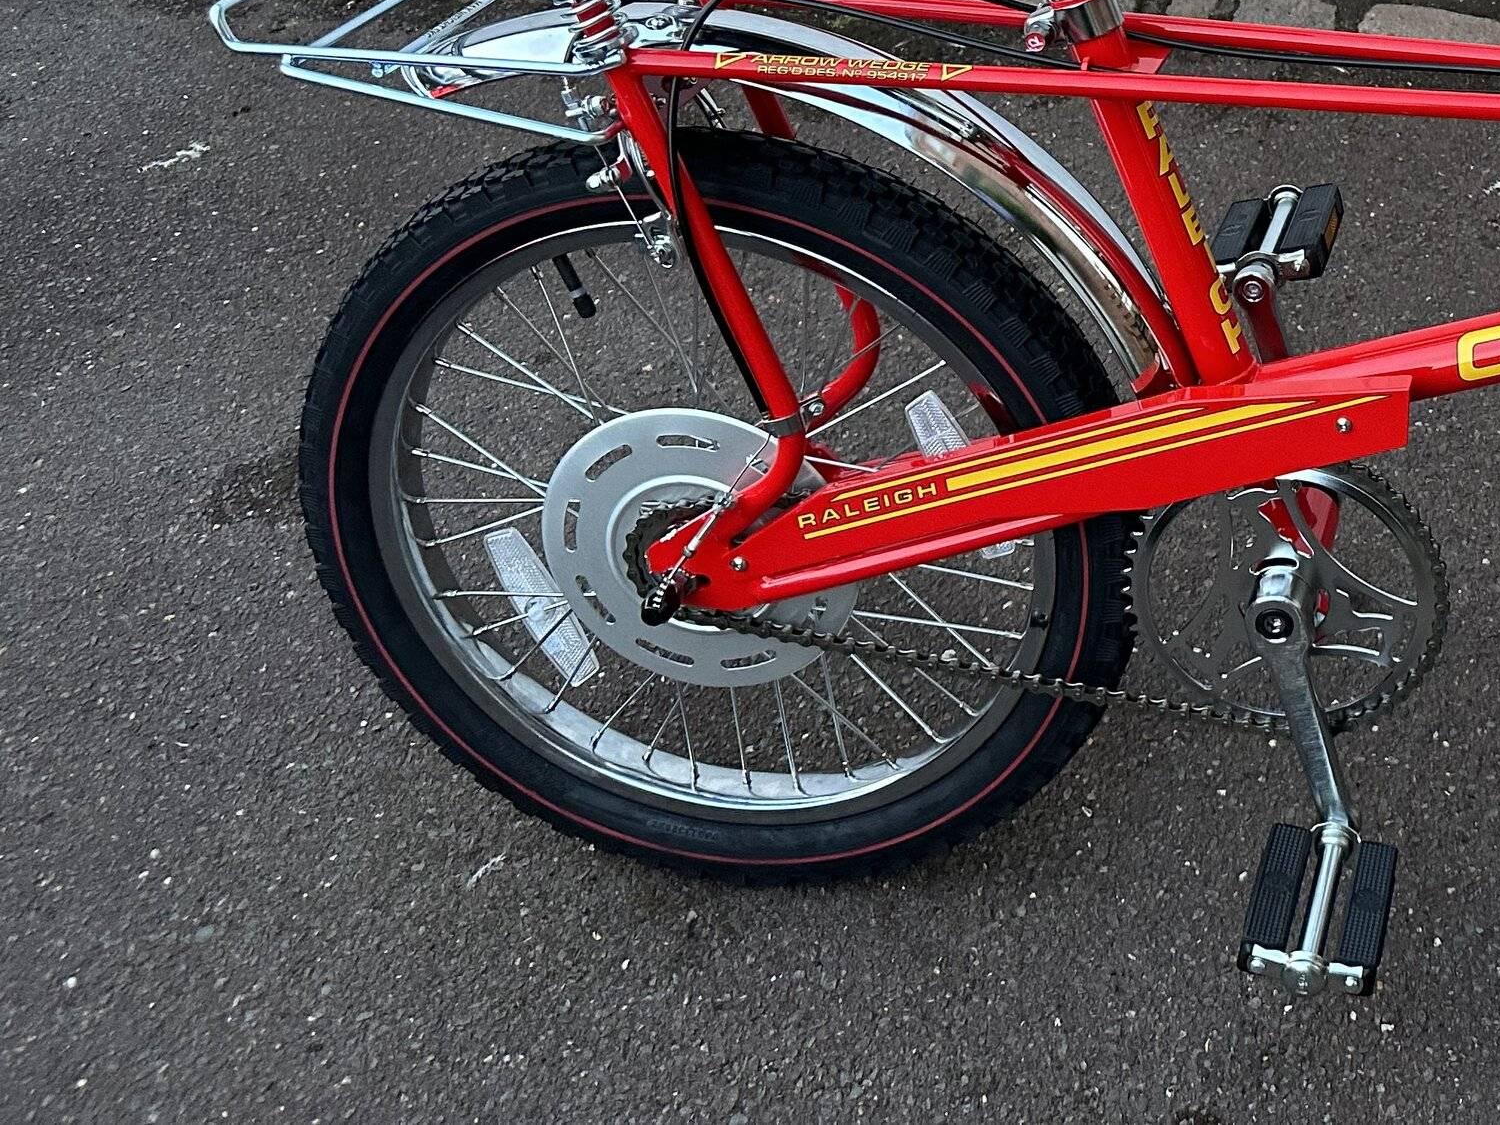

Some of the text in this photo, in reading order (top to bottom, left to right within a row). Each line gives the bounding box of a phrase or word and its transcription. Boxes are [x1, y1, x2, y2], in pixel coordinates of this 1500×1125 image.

[751, 54, 931, 71] ARROW WEDGE
[757, 65, 803, 75] REG'D
[867, 70, 928, 82] 954917
[797, 482, 938, 529] RALEIGH
